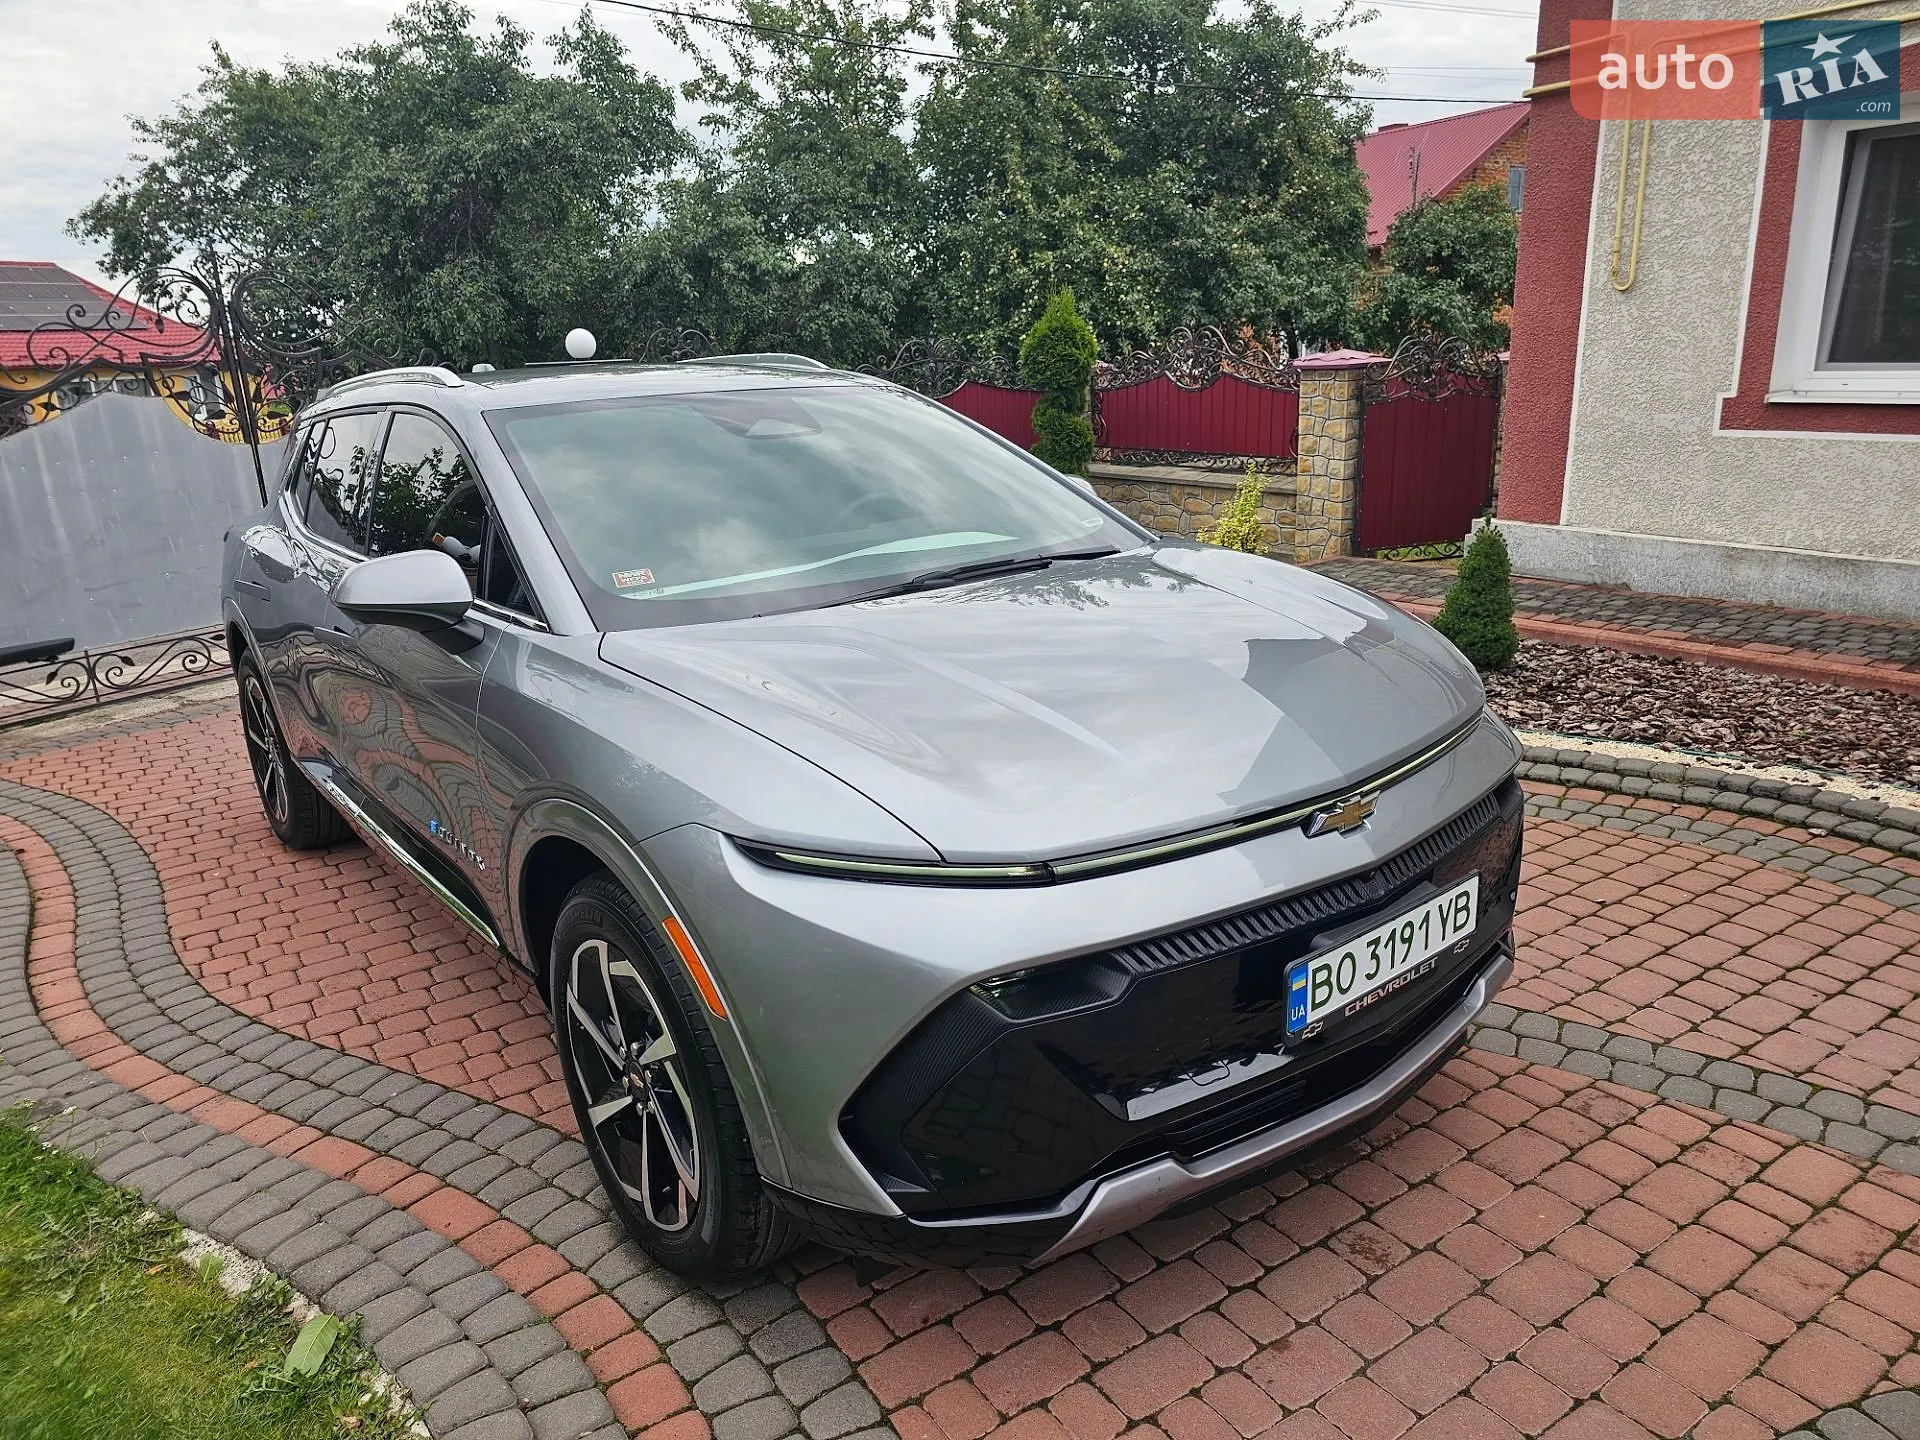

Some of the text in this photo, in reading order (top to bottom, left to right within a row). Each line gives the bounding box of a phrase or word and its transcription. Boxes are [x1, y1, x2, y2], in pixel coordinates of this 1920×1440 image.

[1311, 890, 1471, 1012] BO 3191 YB
[1291, 1004, 1306, 1021] UA
[1344, 956, 1439, 1017] CHEVROLET
